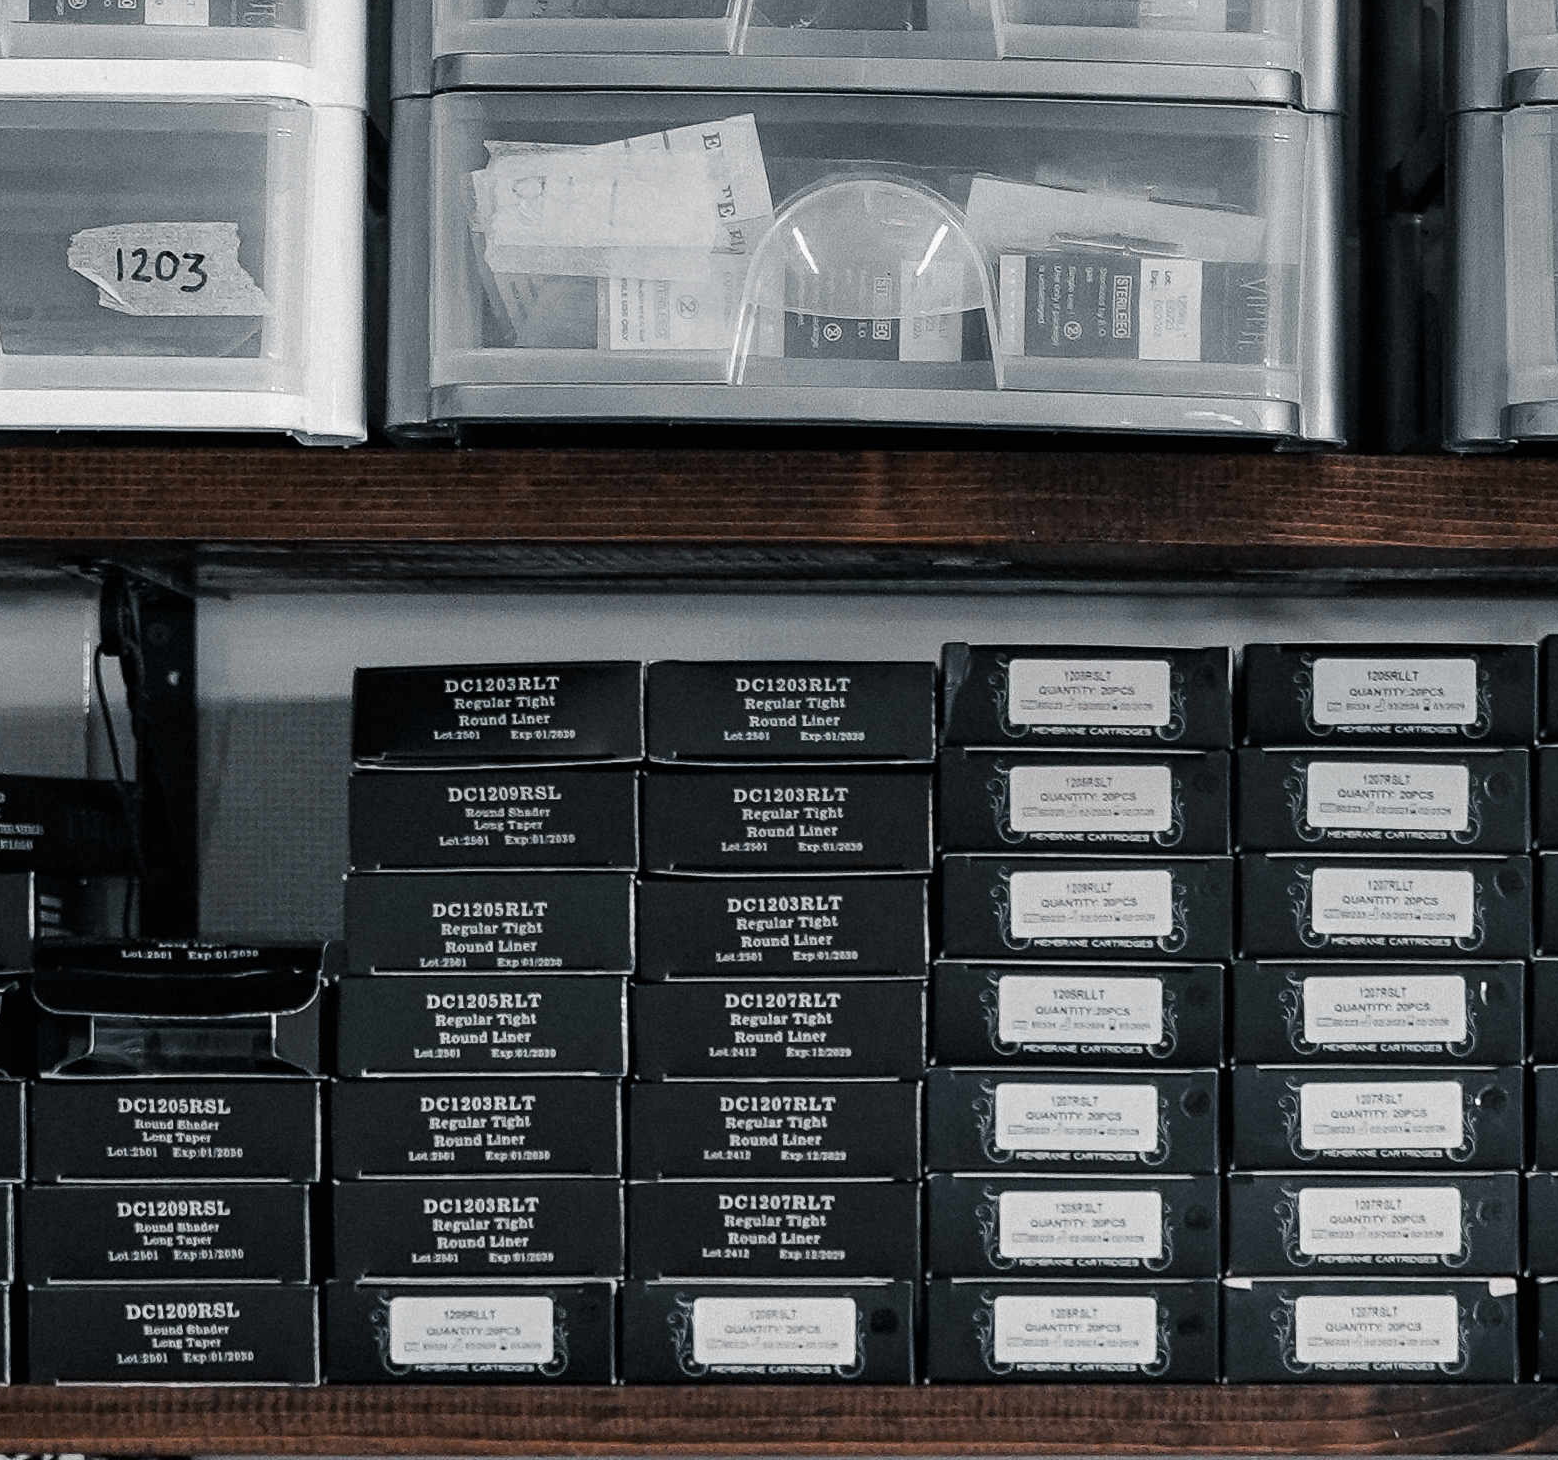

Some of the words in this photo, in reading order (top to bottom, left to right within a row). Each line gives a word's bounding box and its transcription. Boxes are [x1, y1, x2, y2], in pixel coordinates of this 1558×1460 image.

[115, 247, 208, 293] 1203
[445, 676, 559, 692] DC1203RLT
[736, 678, 850, 692] DC1203RLT
[454, 697, 511, 710] Regular
[516, 696, 555, 709] Tight
[744, 698, 801, 711] Regular
[806, 697, 845, 710] Tight
[459, 714, 506, 726] Round
[512, 714, 550, 724] Liner
[749, 715, 796, 727] Round
[802, 715, 840, 726] Liner
[448, 786, 561, 802] DC1209RSL
[734, 788, 848, 802] DC1203RLT
[742, 808, 799, 822] Regular
[803, 807, 843, 820] Tight
[747, 825, 794, 837] Round
[799, 825, 838, 836] Liner
[433, 902, 547, 917] DC1205RLT
[728, 896, 842, 912] DC1203RLT
[427, 993, 541, 1009] DC1205RLT
[725, 993, 841, 1008] DC1207RLT
[421, 1096, 535, 1112] DC1203RLT
[720, 1097, 836, 1111] DC1207RLT
[424, 1197, 539, 1213] DC1203RLT
[719, 1195, 835, 1210] DC1207RLT
